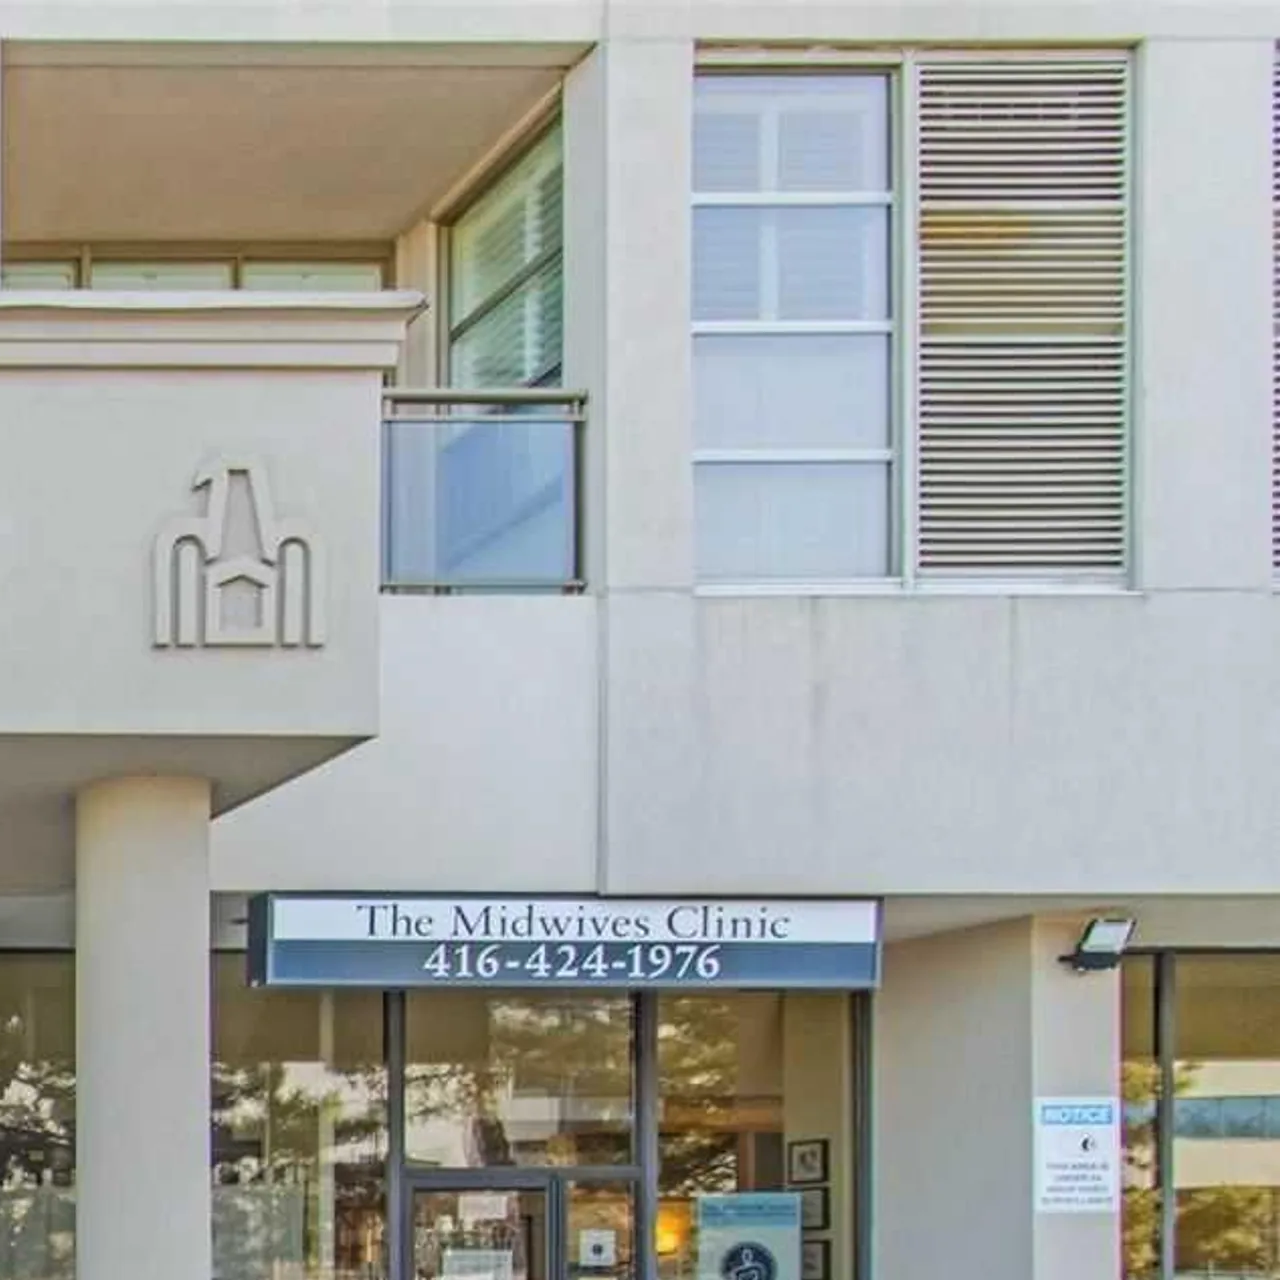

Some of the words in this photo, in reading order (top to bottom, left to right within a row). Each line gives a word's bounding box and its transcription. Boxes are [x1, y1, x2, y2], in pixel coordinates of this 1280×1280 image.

[356, 904, 433, 938] The
[451, 904, 650, 939] Midwives
[666, 904, 791, 939] Clinic
[422, 943, 721, 978] 416-424-1976
